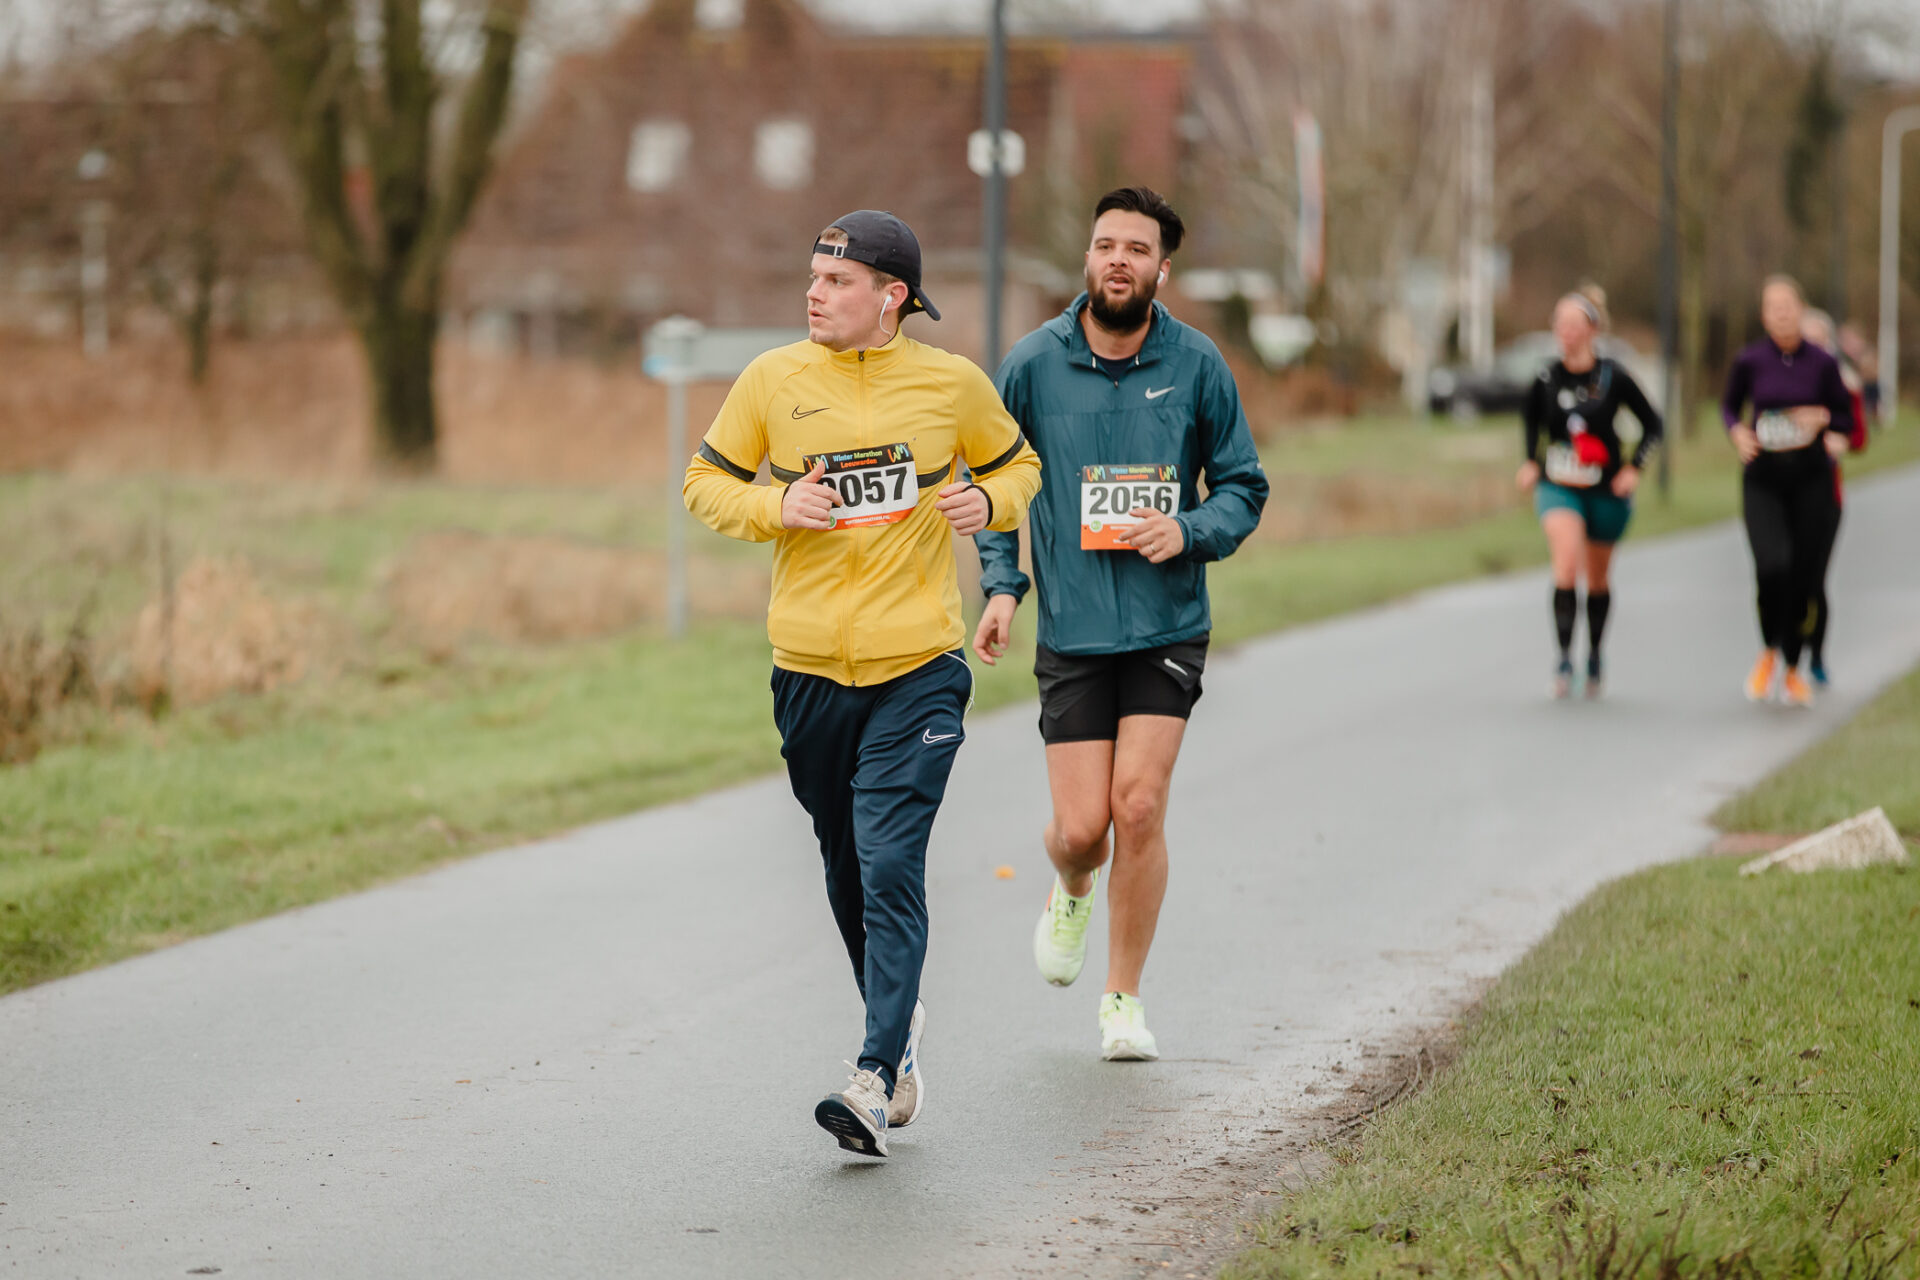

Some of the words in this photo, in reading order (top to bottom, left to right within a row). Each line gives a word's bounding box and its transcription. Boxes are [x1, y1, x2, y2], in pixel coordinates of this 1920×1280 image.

[833, 454, 853, 462] Winter
[853, 450, 883, 459] Marathon
[1089, 486, 1173, 515] 2056
